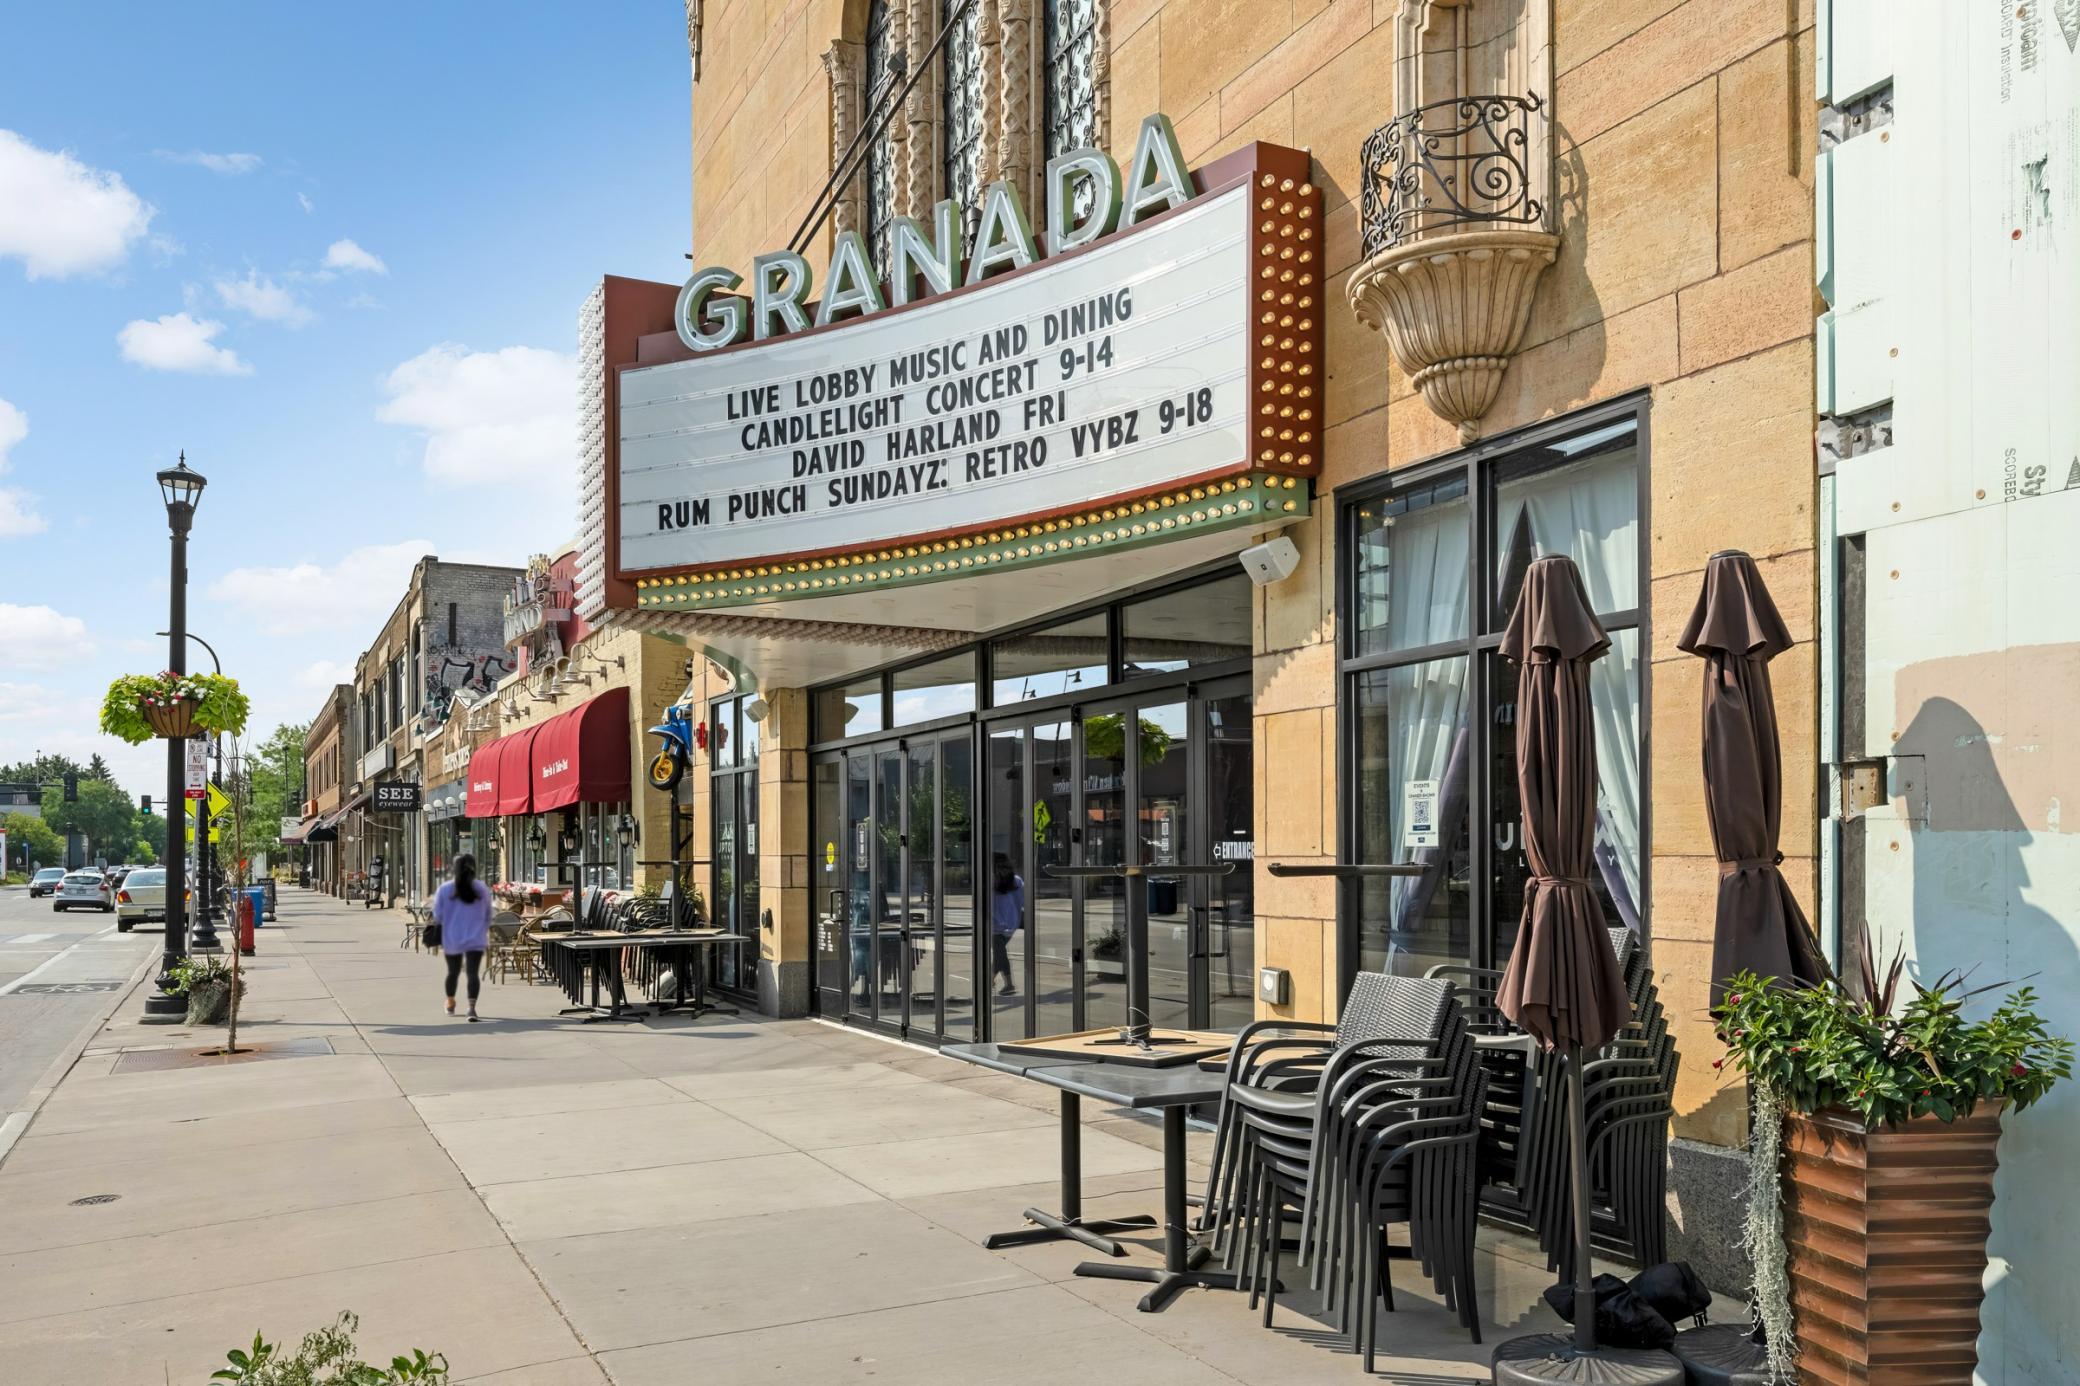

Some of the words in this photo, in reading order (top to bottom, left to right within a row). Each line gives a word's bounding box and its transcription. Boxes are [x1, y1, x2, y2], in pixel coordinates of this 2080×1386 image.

[674, 112, 1197, 352] GRANADA
[727, 385, 779, 420] LIVE
[796, 364, 876, 408] LOBBY
[890, 340, 966, 388] MUSIC
[978, 324, 1028, 366] AND
[1043, 287, 1132, 347] DINING
[741, 394, 904, 451] CANDLELIGHT
[926, 358, 1039, 415] CONCERT
[1060, 335, 1114, 381] 9-14
[658, 498, 710, 531] RUM
[728, 484, 806, 522] PUNCH
[828, 457, 948, 508] SUNDAYZ:
[965, 436, 1047, 483] RETRO
[1070, 409, 1139, 458] VYBZ
[1158, 387, 1213, 435] 9-18
[792, 439, 865, 478] DAVID
[887, 408, 1000, 462] HARLAND
[1023, 390, 1066, 431] FRI
[378, 787, 414, 800] SEE
[378, 800, 413, 809] eyewear
